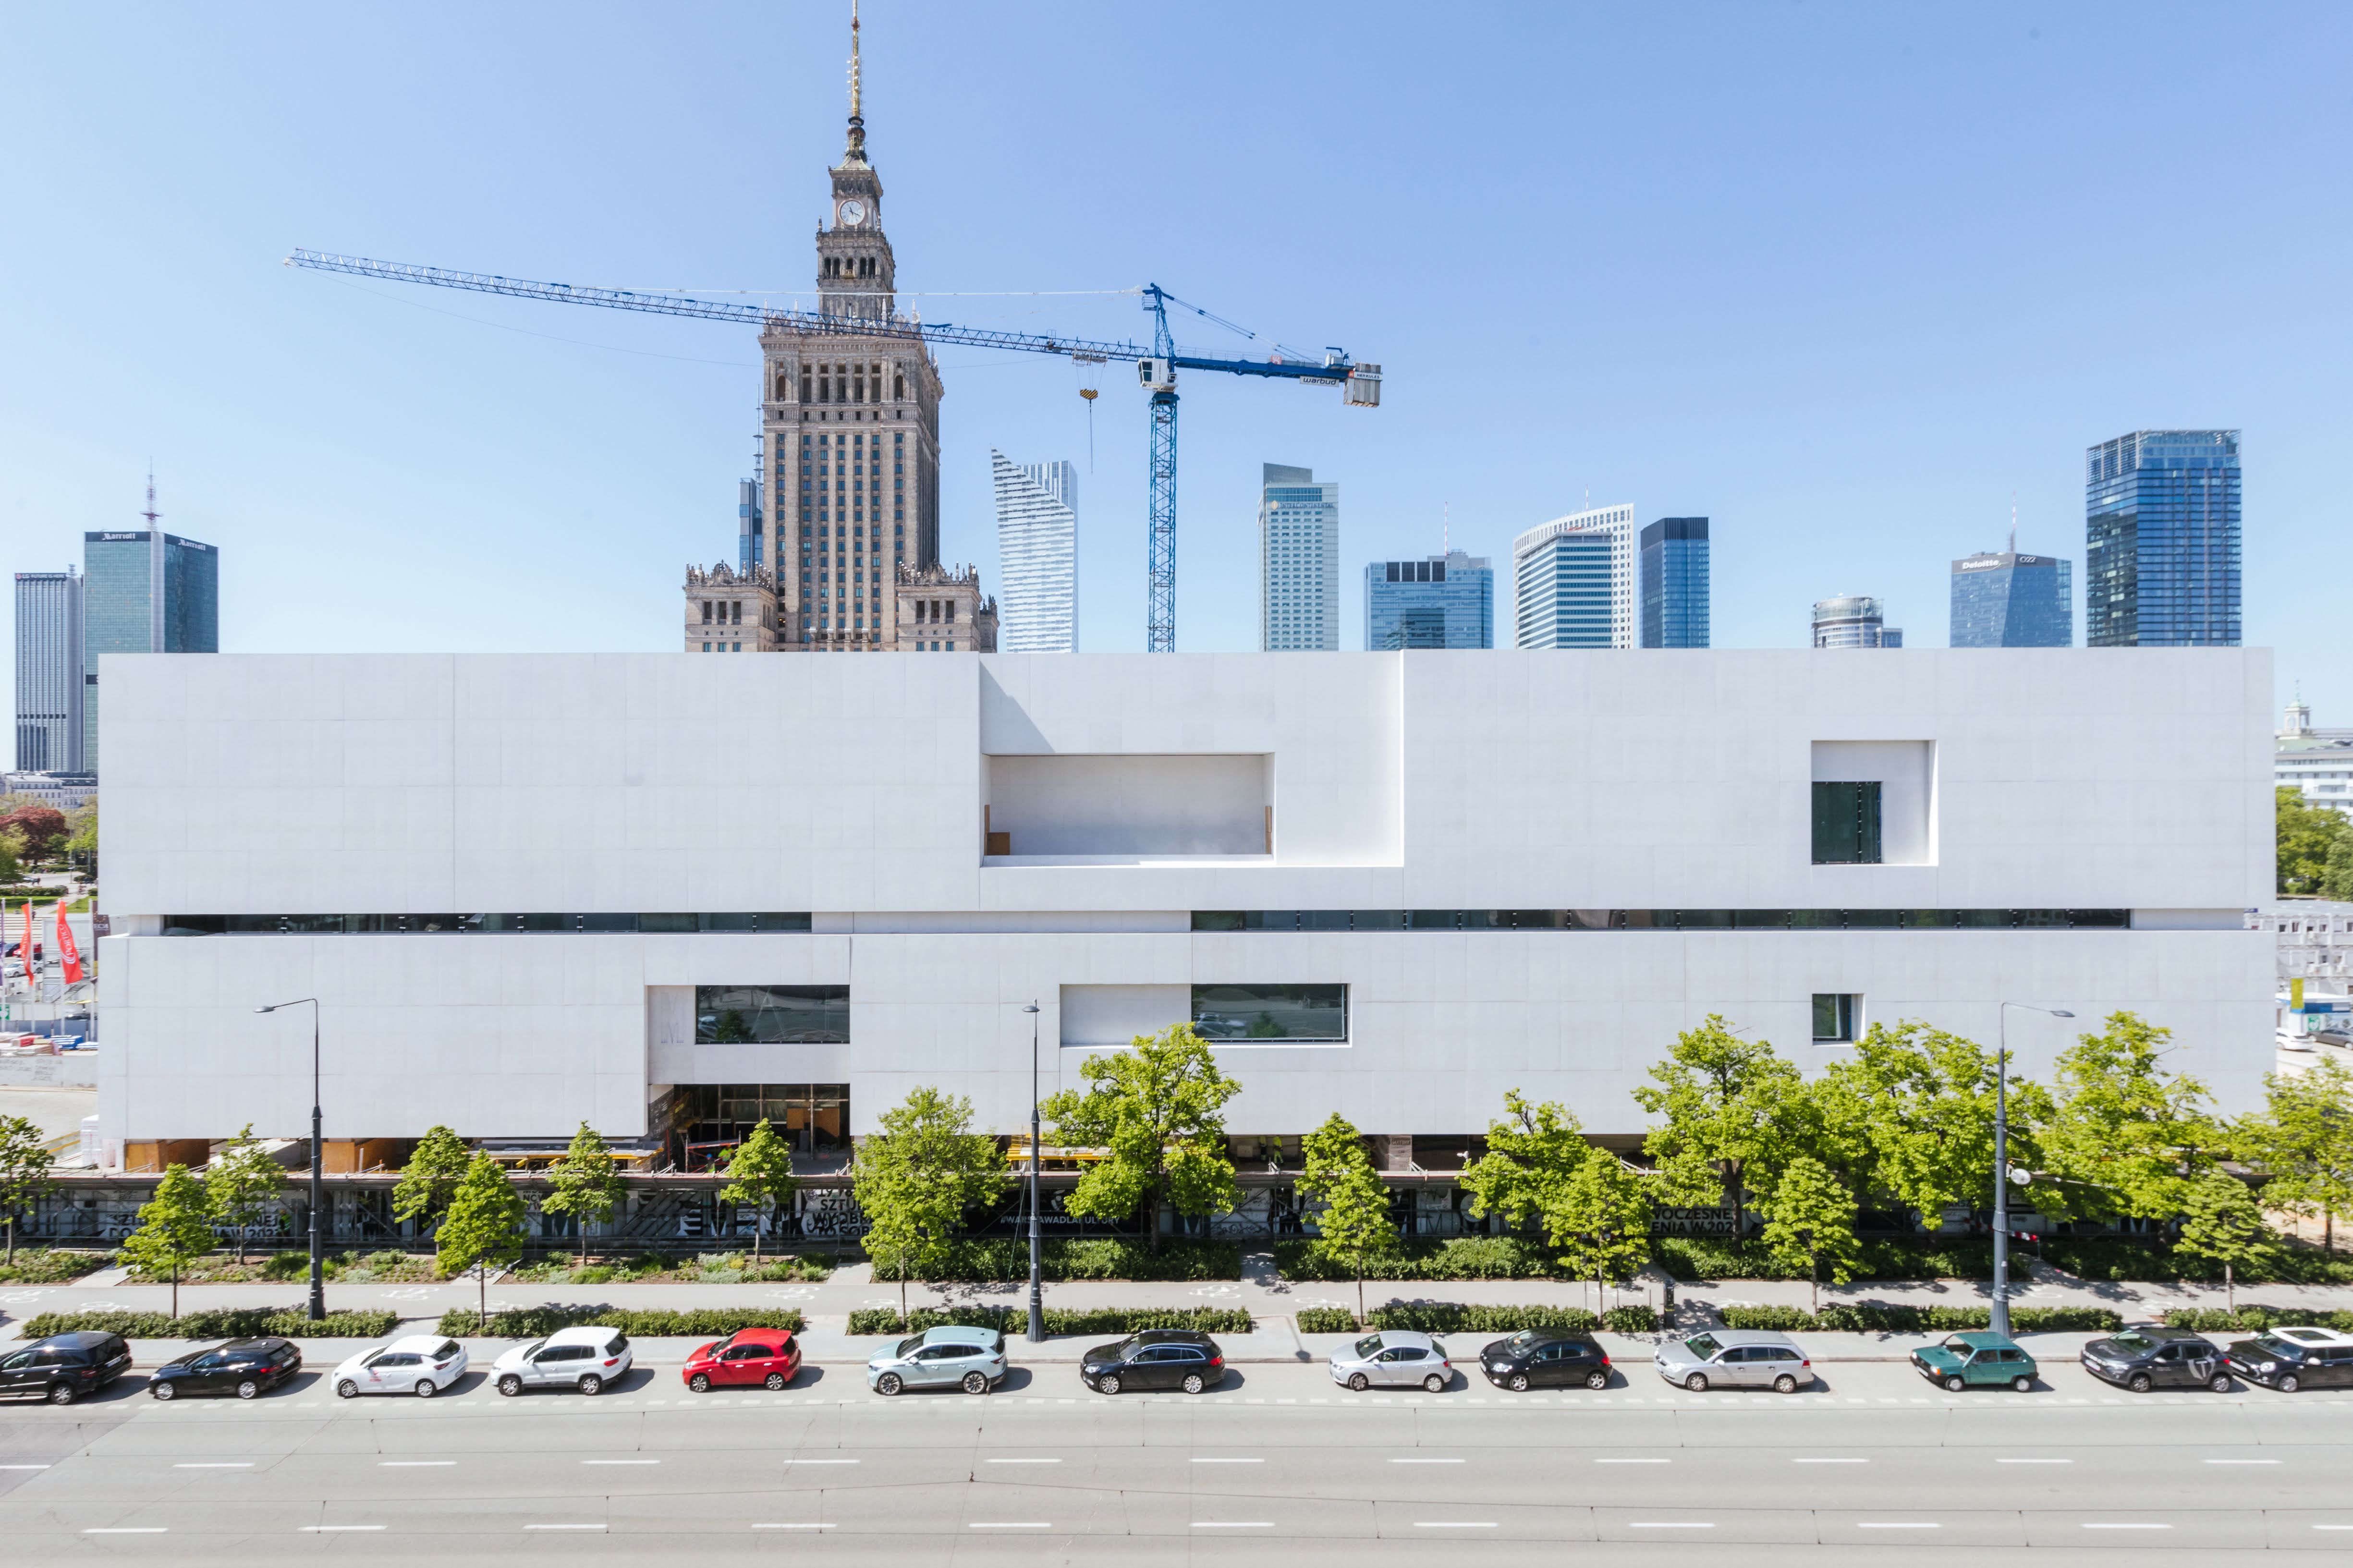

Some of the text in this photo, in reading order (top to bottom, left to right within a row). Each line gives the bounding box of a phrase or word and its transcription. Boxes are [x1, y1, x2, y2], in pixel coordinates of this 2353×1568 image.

[102, 533, 136, 541] Marriott
[178, 538, 206, 551] Marriott
[1707, 1221, 1733, 1233] 202
